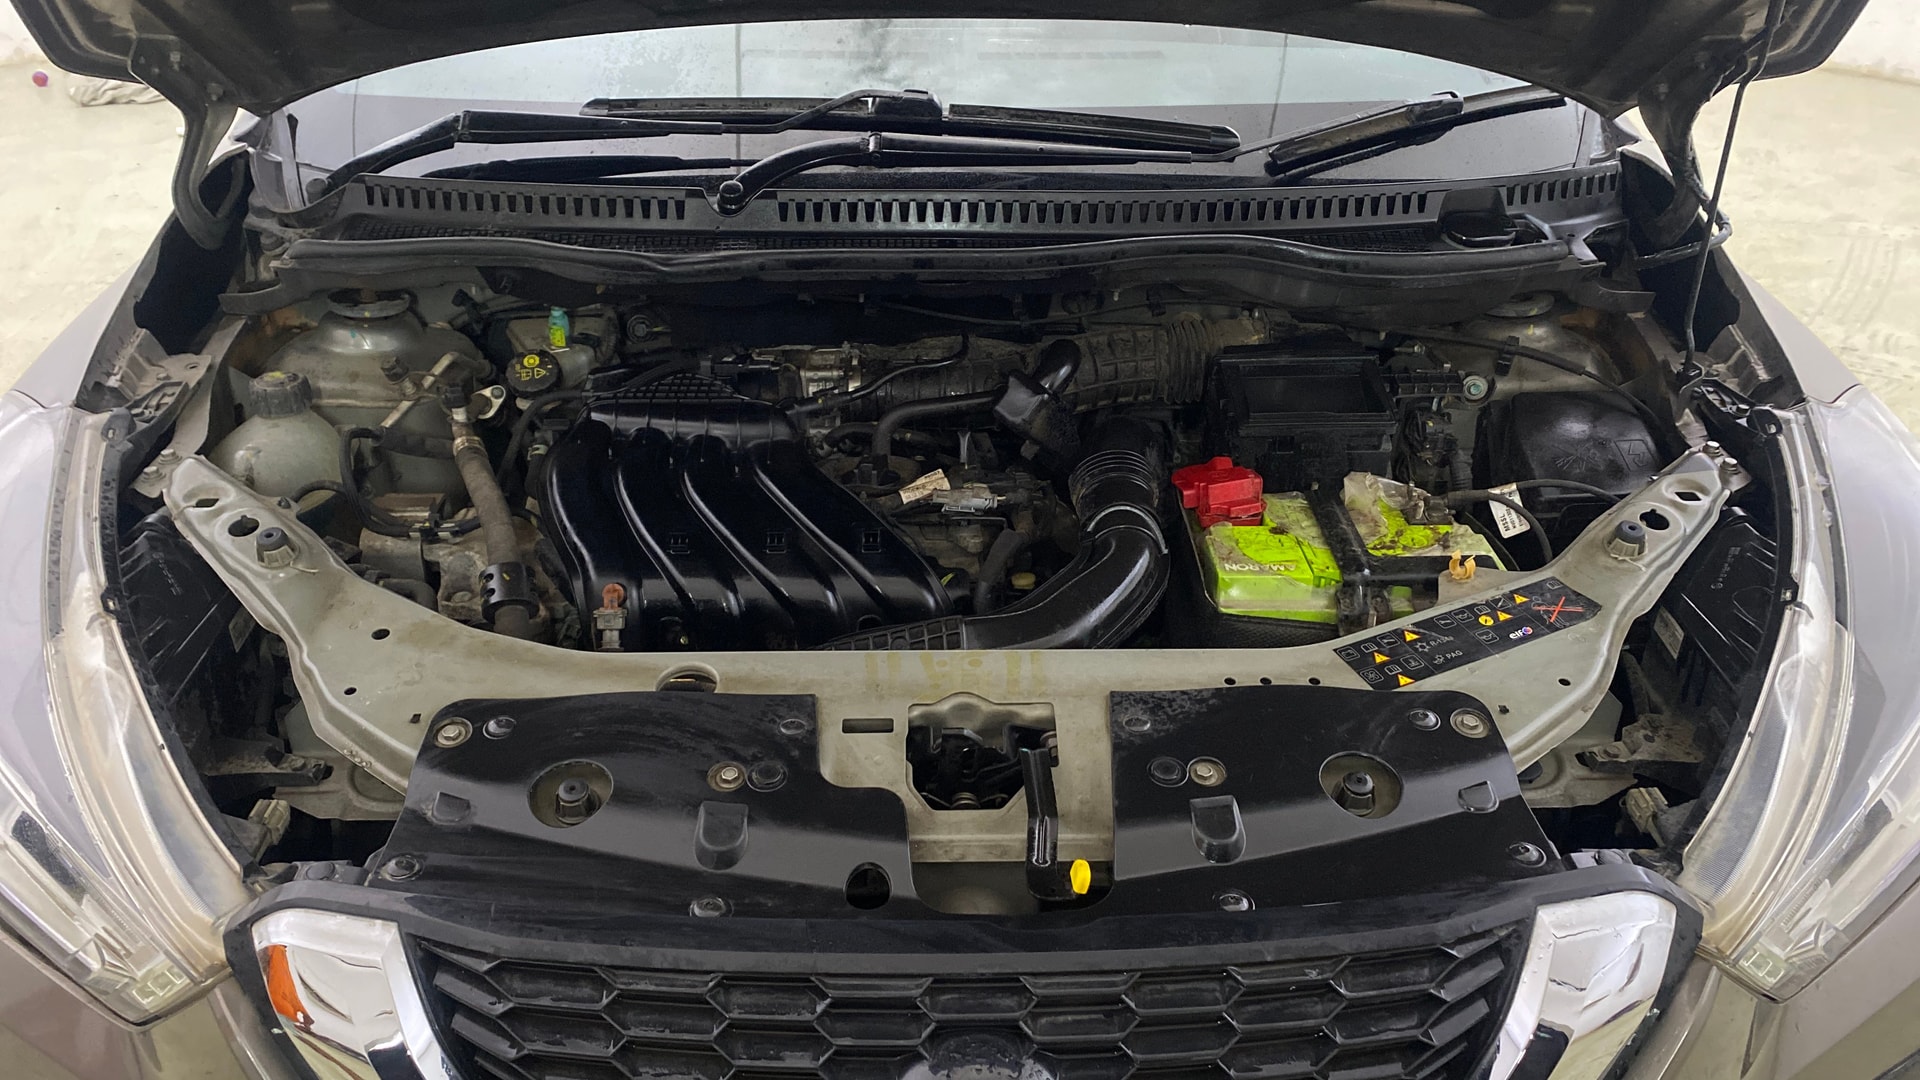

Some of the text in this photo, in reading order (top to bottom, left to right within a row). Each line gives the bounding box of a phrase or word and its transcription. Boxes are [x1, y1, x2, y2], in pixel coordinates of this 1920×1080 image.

[1224, 562, 1297, 572] AMARON
[1509, 628, 1524, 640] elf
[1445, 649, 1464, 660] PAG
